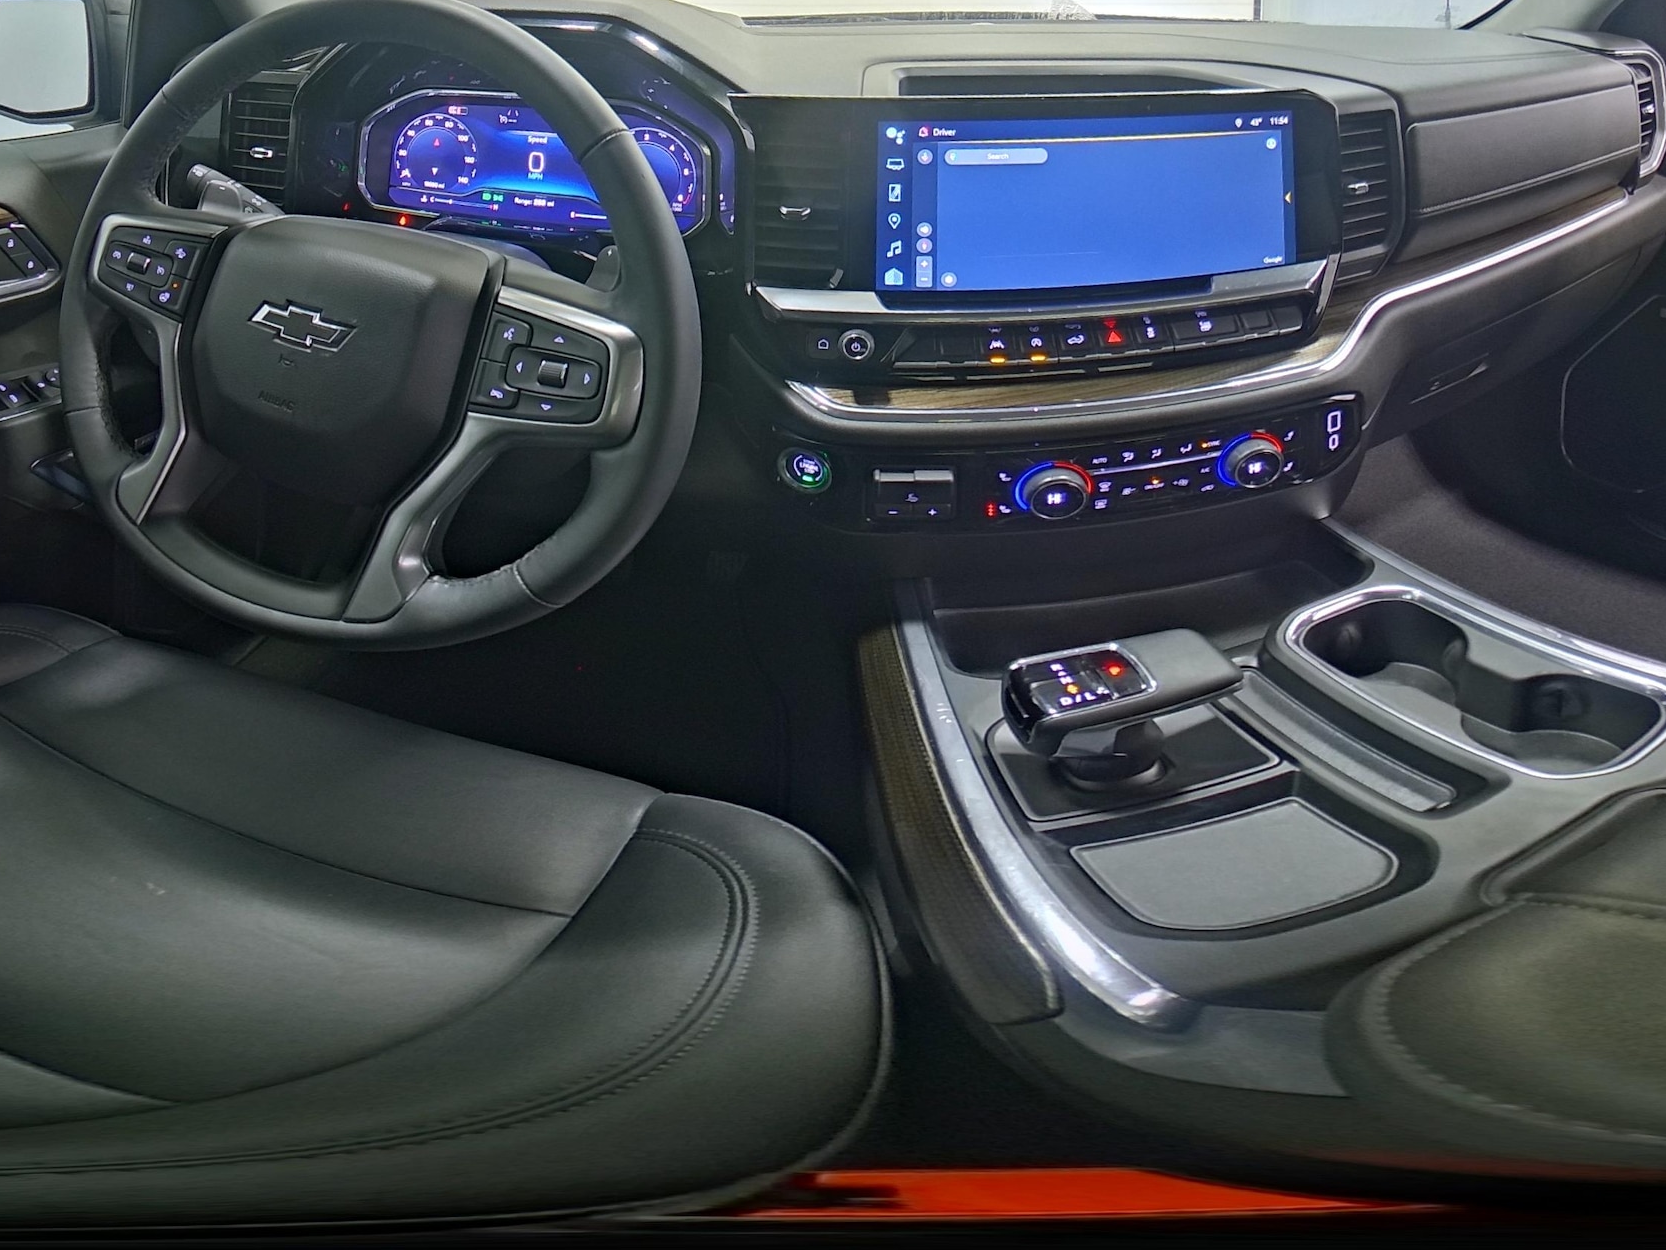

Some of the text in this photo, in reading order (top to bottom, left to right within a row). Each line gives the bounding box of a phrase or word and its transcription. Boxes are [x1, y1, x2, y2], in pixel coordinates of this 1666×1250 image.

[1269, 115, 1289, 126] 11:54
[932, 127, 957, 138] Driver
[528, 135, 548, 145] Speed
[987, 152, 1009, 160] Search
[528, 151, 545, 173] 0
[528, 172, 543, 181] MPH
[1263, 255, 1283, 264] Google
[1248, 462, 1261, 474] HI
[1047, 492, 1062, 505] HI
